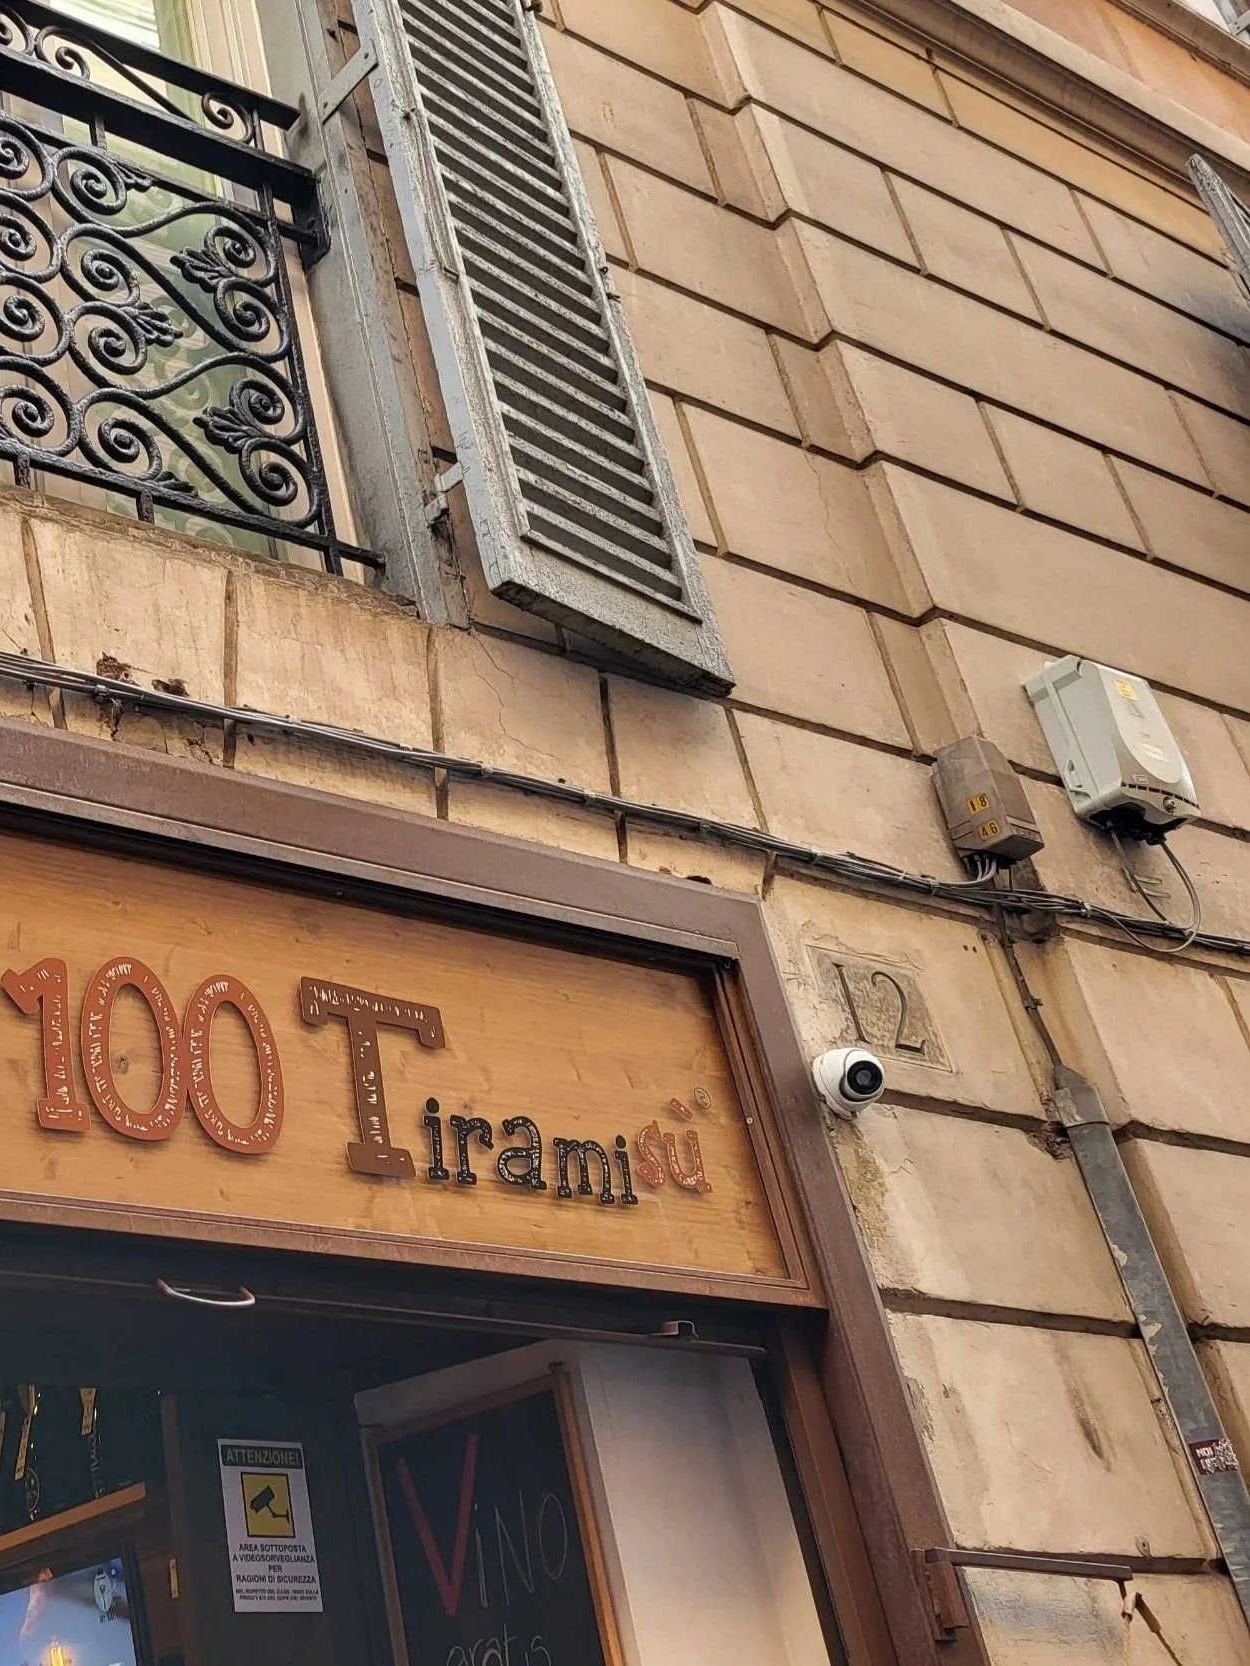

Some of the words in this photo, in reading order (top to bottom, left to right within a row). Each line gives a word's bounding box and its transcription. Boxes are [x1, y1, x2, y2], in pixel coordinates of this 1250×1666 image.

[969, 795, 988, 812] 18
[980, 822, 999, 838] 46
[831, 962, 927, 1056] 12
[0, 956, 285, 1155] 100
[226, 1448, 300, 1466] ATTENZIONE!
[239, 1544, 259, 1552] AREA
[260, 1544, 307, 1553] SOTTOPOSTA
[232, 1554, 238, 1562] A
[239, 1554, 316, 1564] VIDEOSORVEGLIANZA
[268, 1565, 283, 1573] PER
[236, 1575, 267, 1583] RAGIONI
[268, 1575, 276, 1583] DI
[277, 1575, 317, 1584] SICUREZZA
